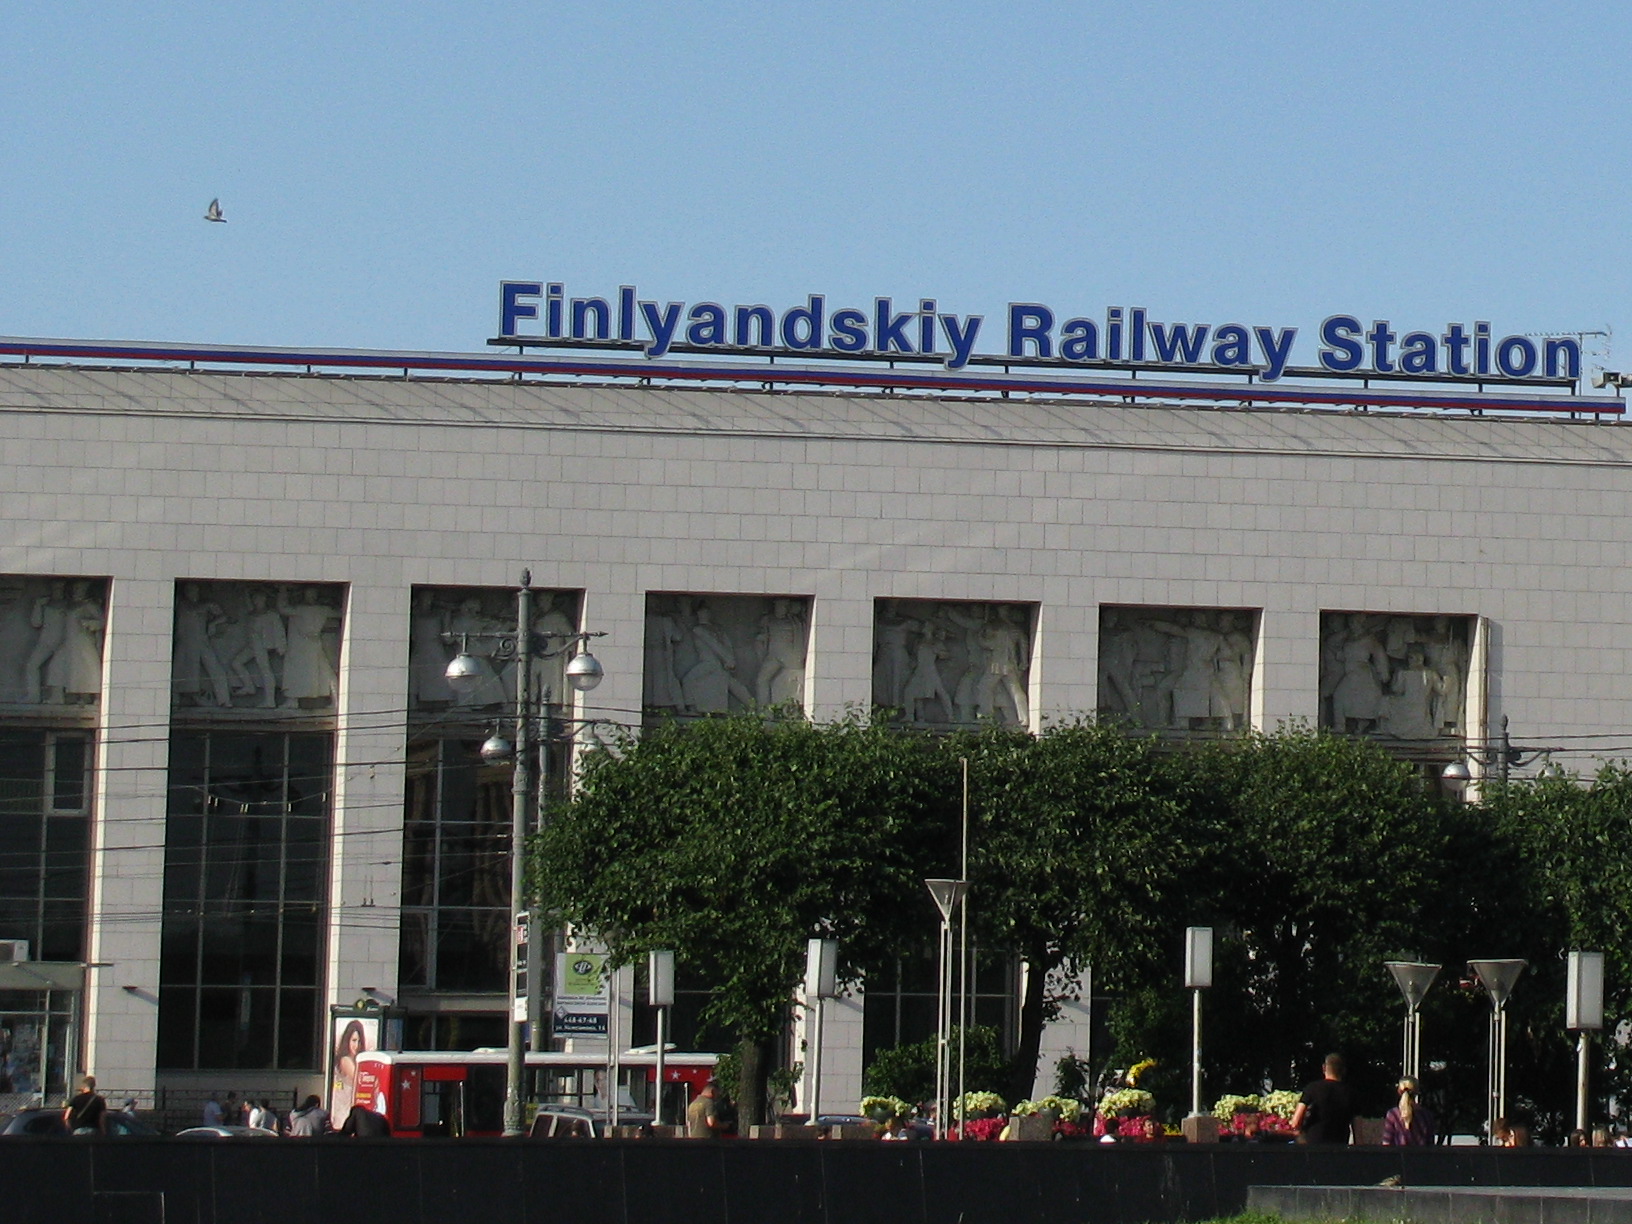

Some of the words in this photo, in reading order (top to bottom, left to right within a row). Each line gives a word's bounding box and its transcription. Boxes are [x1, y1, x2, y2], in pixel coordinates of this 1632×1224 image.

[499, 281, 983, 370] Finlyandskiy
[1008, 303, 1297, 382] Railway
[1320, 315, 1582, 380] Station
